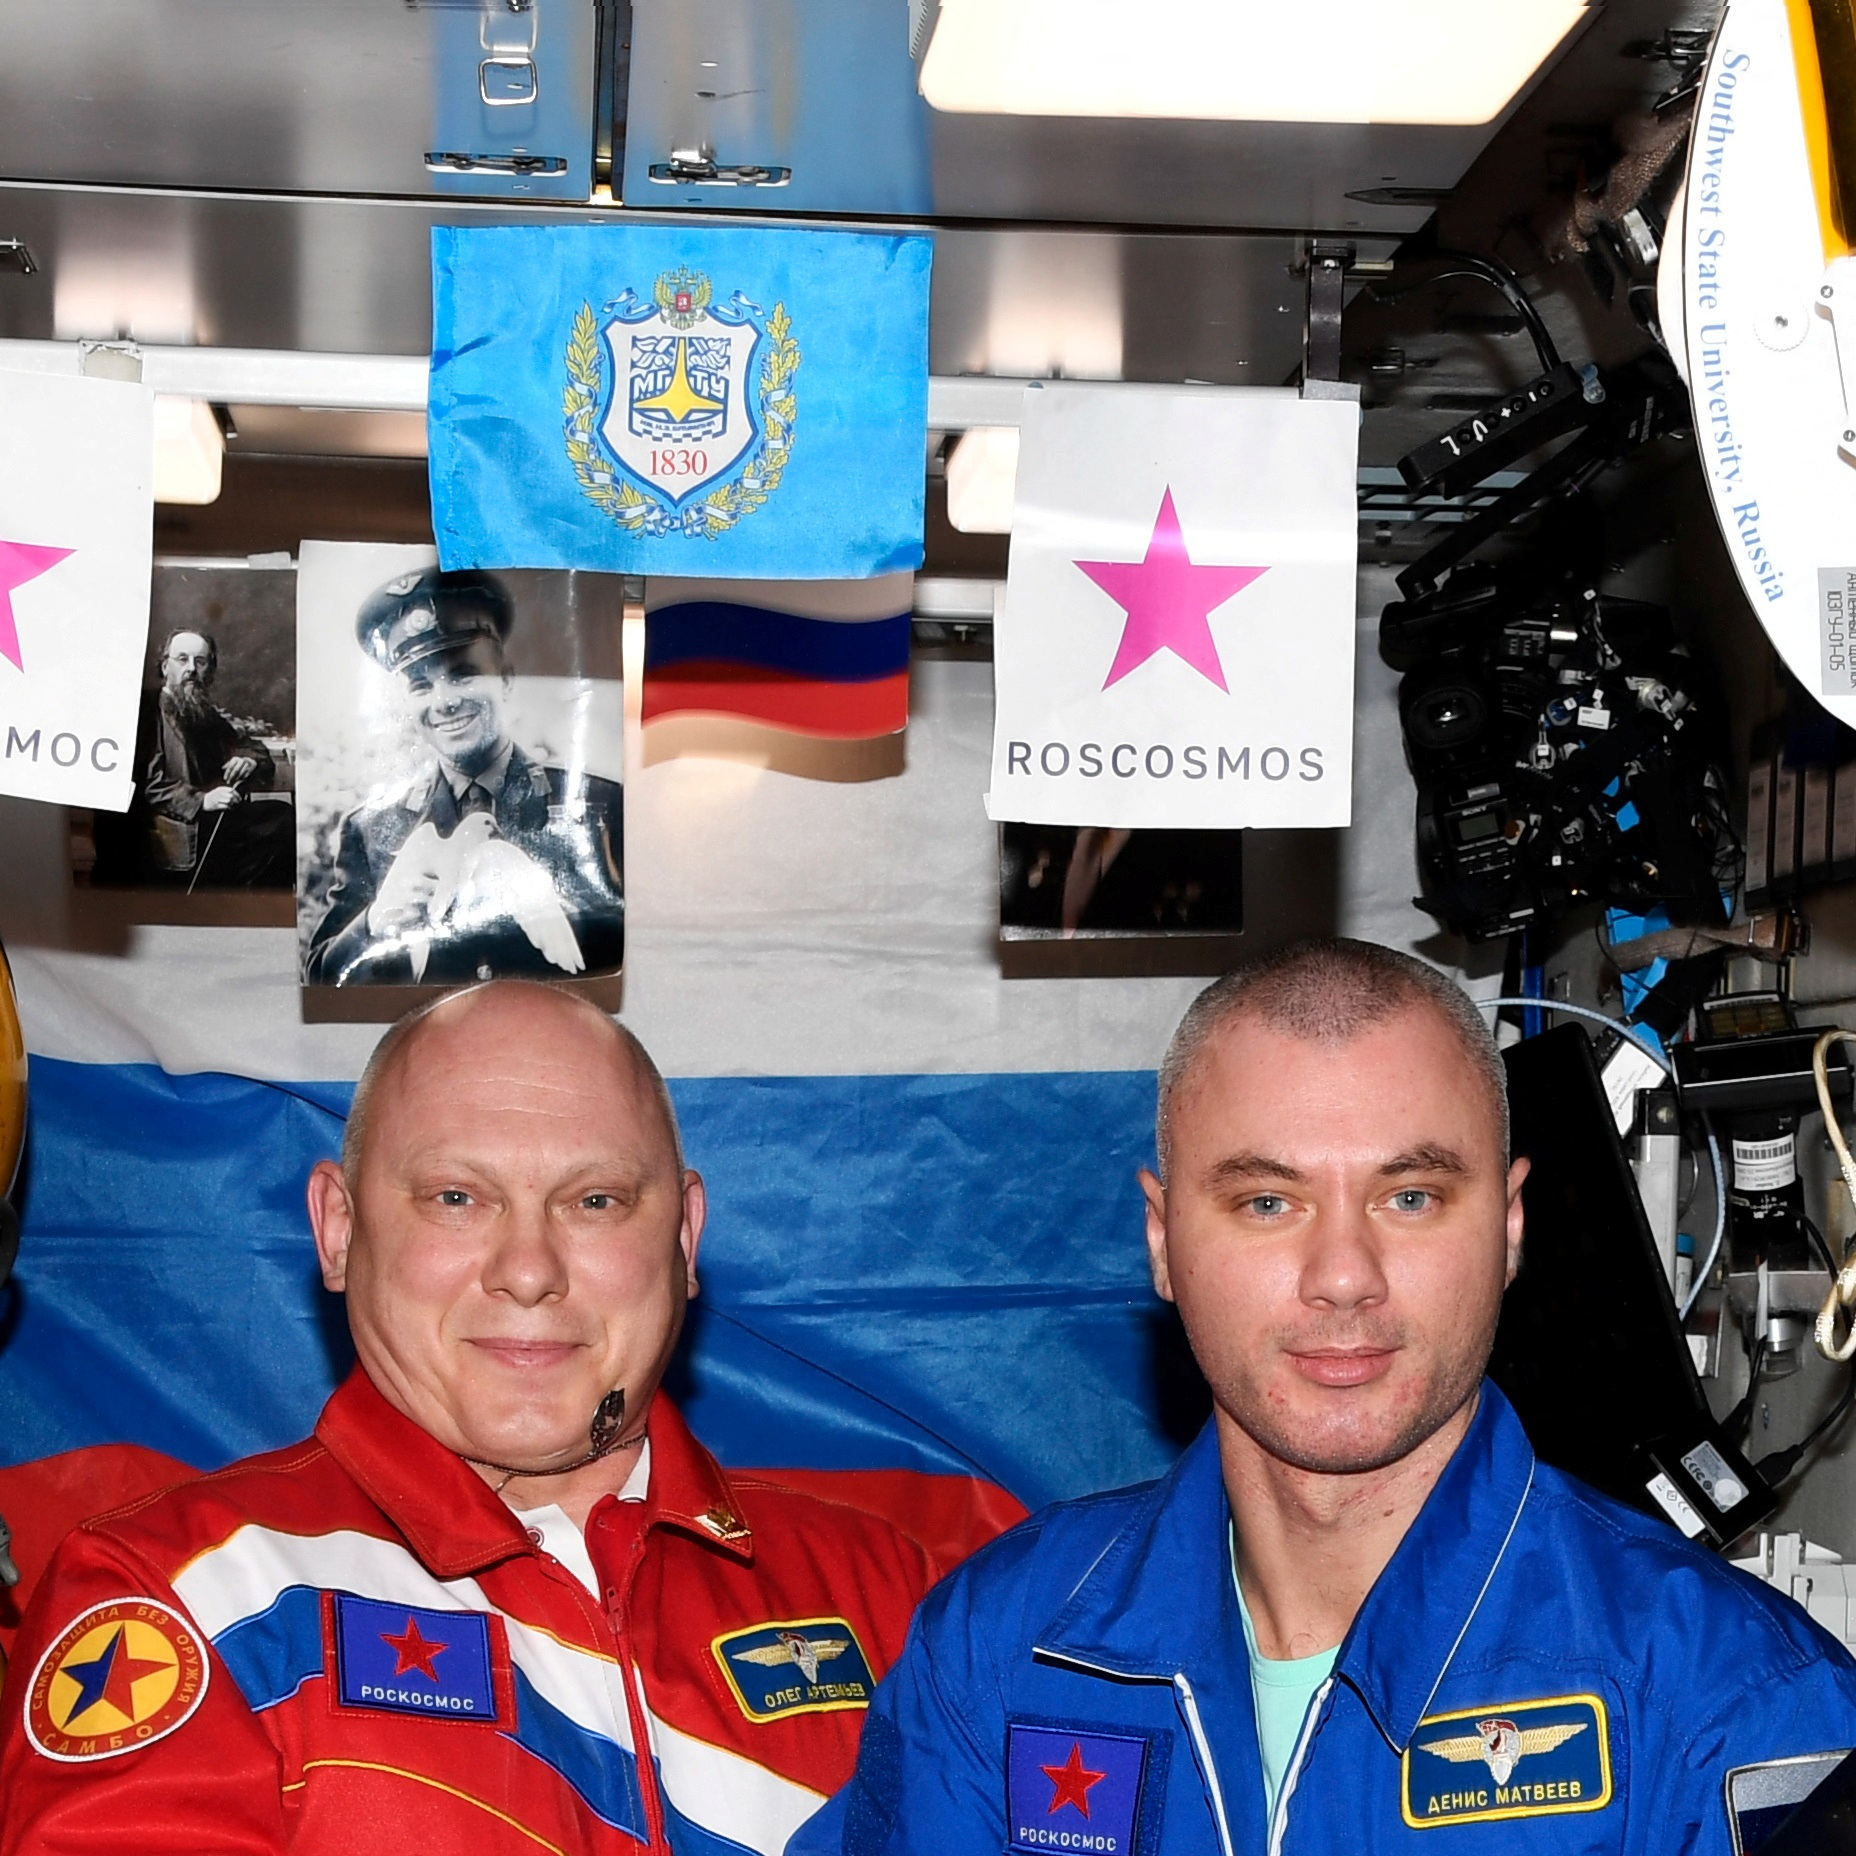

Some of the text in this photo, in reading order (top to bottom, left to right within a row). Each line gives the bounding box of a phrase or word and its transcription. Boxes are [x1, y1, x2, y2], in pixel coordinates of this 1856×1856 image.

[1697, 50, 1785, 602] Southwest State University, Russia
[650, 449, 708, 476] 1830
[1826, 590, 1845, 671] ЮЗГУ-01-05
[1007, 741, 1324, 781] ROSCOSMOS
[32, 1605, 199, 1711] САМОЗАЩИТА БЕЗ ОРУЖИЯ
[361, 1685, 475, 1711] РОСКОСМОС
[764, 1682, 866, 1708] ОЛЕГ АРТЕМЬЕВ
[43, 1724, 154, 1754] САМБО
[1428, 1780, 1582, 1815] ДЕНИС МАТВЕЕВ
[1019, 1827, 1117, 1852] РОСКОСМОС
